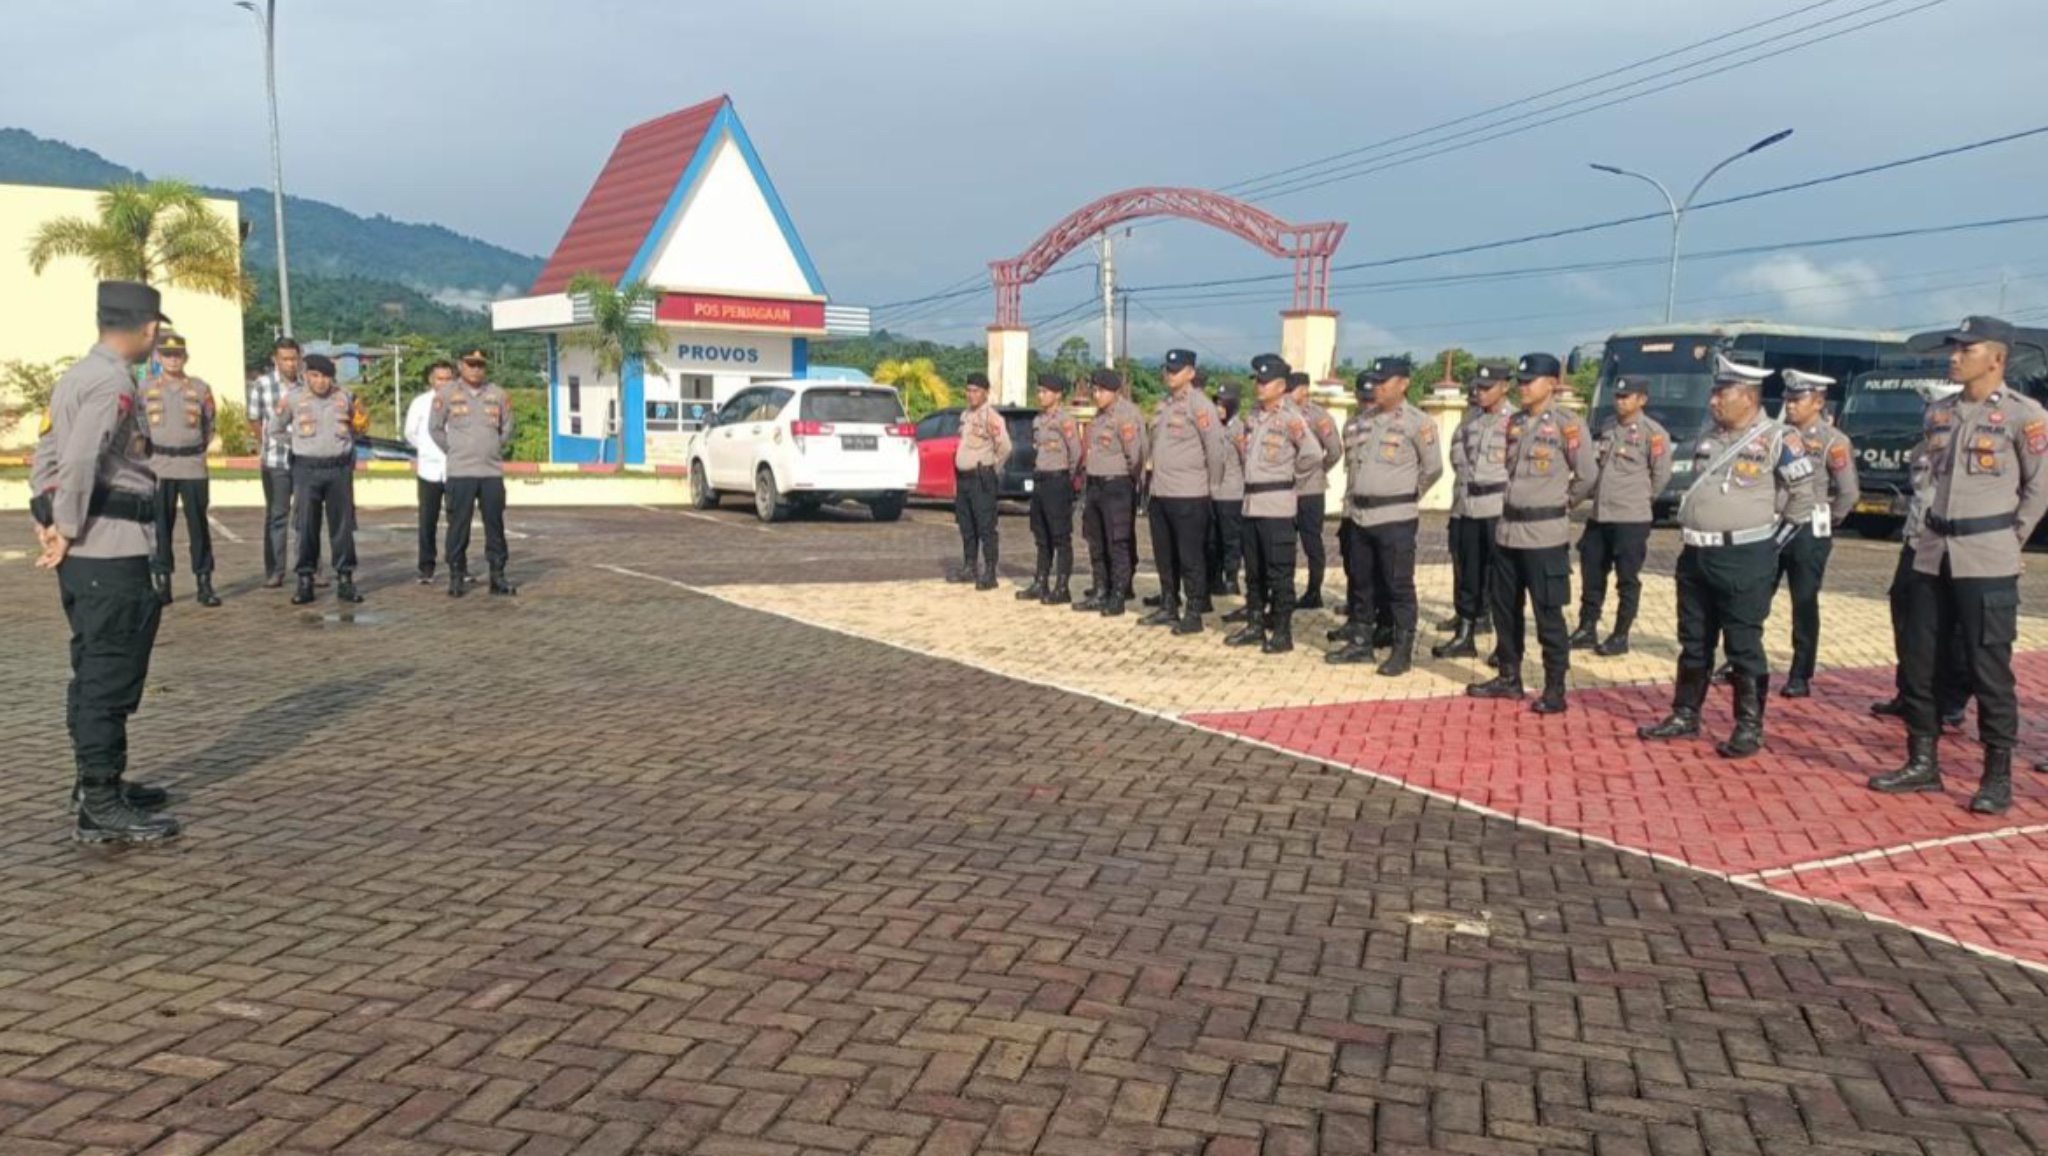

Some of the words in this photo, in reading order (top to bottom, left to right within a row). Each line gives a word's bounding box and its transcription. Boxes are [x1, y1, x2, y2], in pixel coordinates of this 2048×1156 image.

[694, 303, 719, 317] POS
[722, 305, 791, 322] PENJAGAAN
[678, 345, 758, 363] PROVOS
[1865, 379, 1899, 390] POLRES
